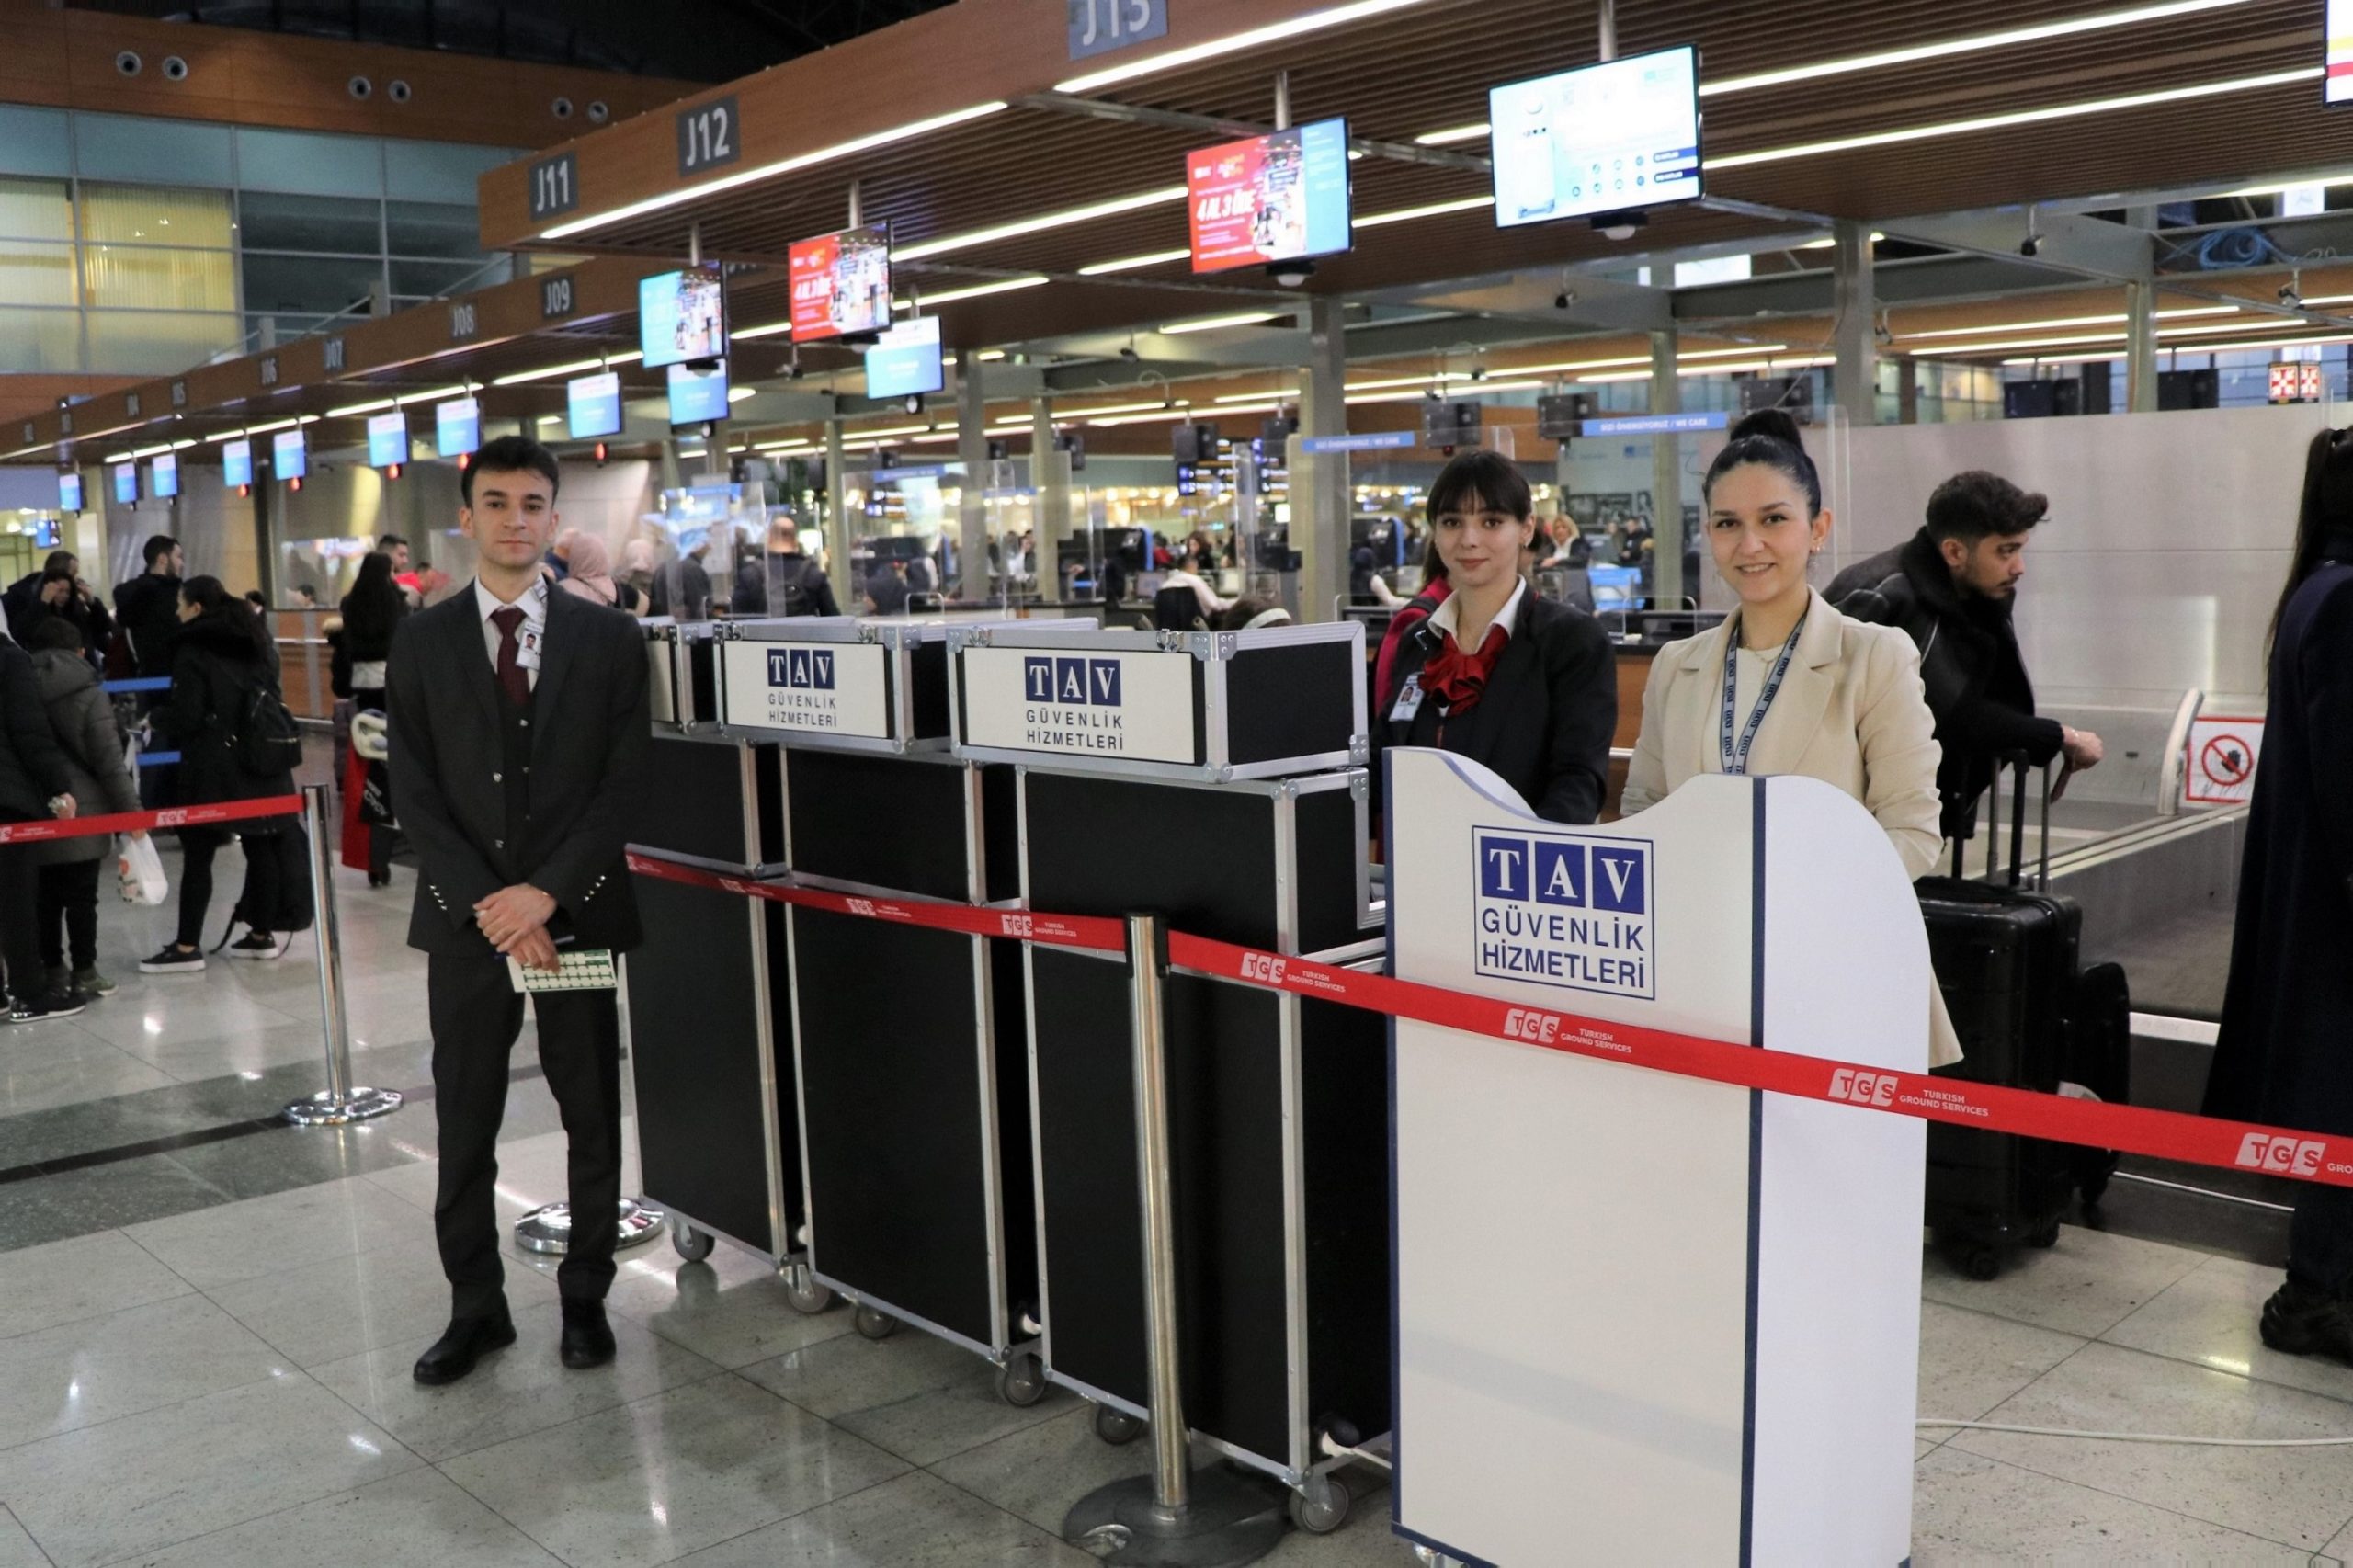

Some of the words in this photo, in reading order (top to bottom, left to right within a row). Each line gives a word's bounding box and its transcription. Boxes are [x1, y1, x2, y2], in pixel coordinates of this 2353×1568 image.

[687, 107, 731, 167] J12
[536, 160, 569, 212] J11
[545, 278, 571, 314] J09
[453, 304, 474, 337] J08
[769, 652, 833, 687] TAV
[1028, 660, 1119, 703] TAV
[768, 691, 836, 710] GÜVENLİK
[769, 709, 837, 727] HİZMETLERİ
[1026, 707, 1122, 729] GÜVENLİK
[1027, 727, 1123, 751] HİZMETLERİ
[1484, 842, 1641, 909] TAV
[1004, 916, 1032, 936] TGS
[1482, 904, 1644, 952] GÜVENLİK
[1244, 954, 1285, 982] TGS
[1302, 970, 1330, 981] TURKISH
[1483, 938, 1644, 989] HİZMETLERİ
[1287, 973, 1313, 986] GROUND
[1314, 978, 1346, 993] SERVICES
[1507, 1011, 1559, 1040] TGS
[1579, 1028, 1613, 1040] TURKISH
[1560, 1032, 1593, 1046] GROUND
[1594, 1039, 1632, 1053] SERVICES
[1834, 1072, 1896, 1104] TGS
[1922, 1089, 1965, 1104] TURKISH
[1899, 1095, 1940, 1108] GROUND
[1941, 1101, 1989, 1117] SERVICES
[2242, 1136, 2323, 1173] TGS
